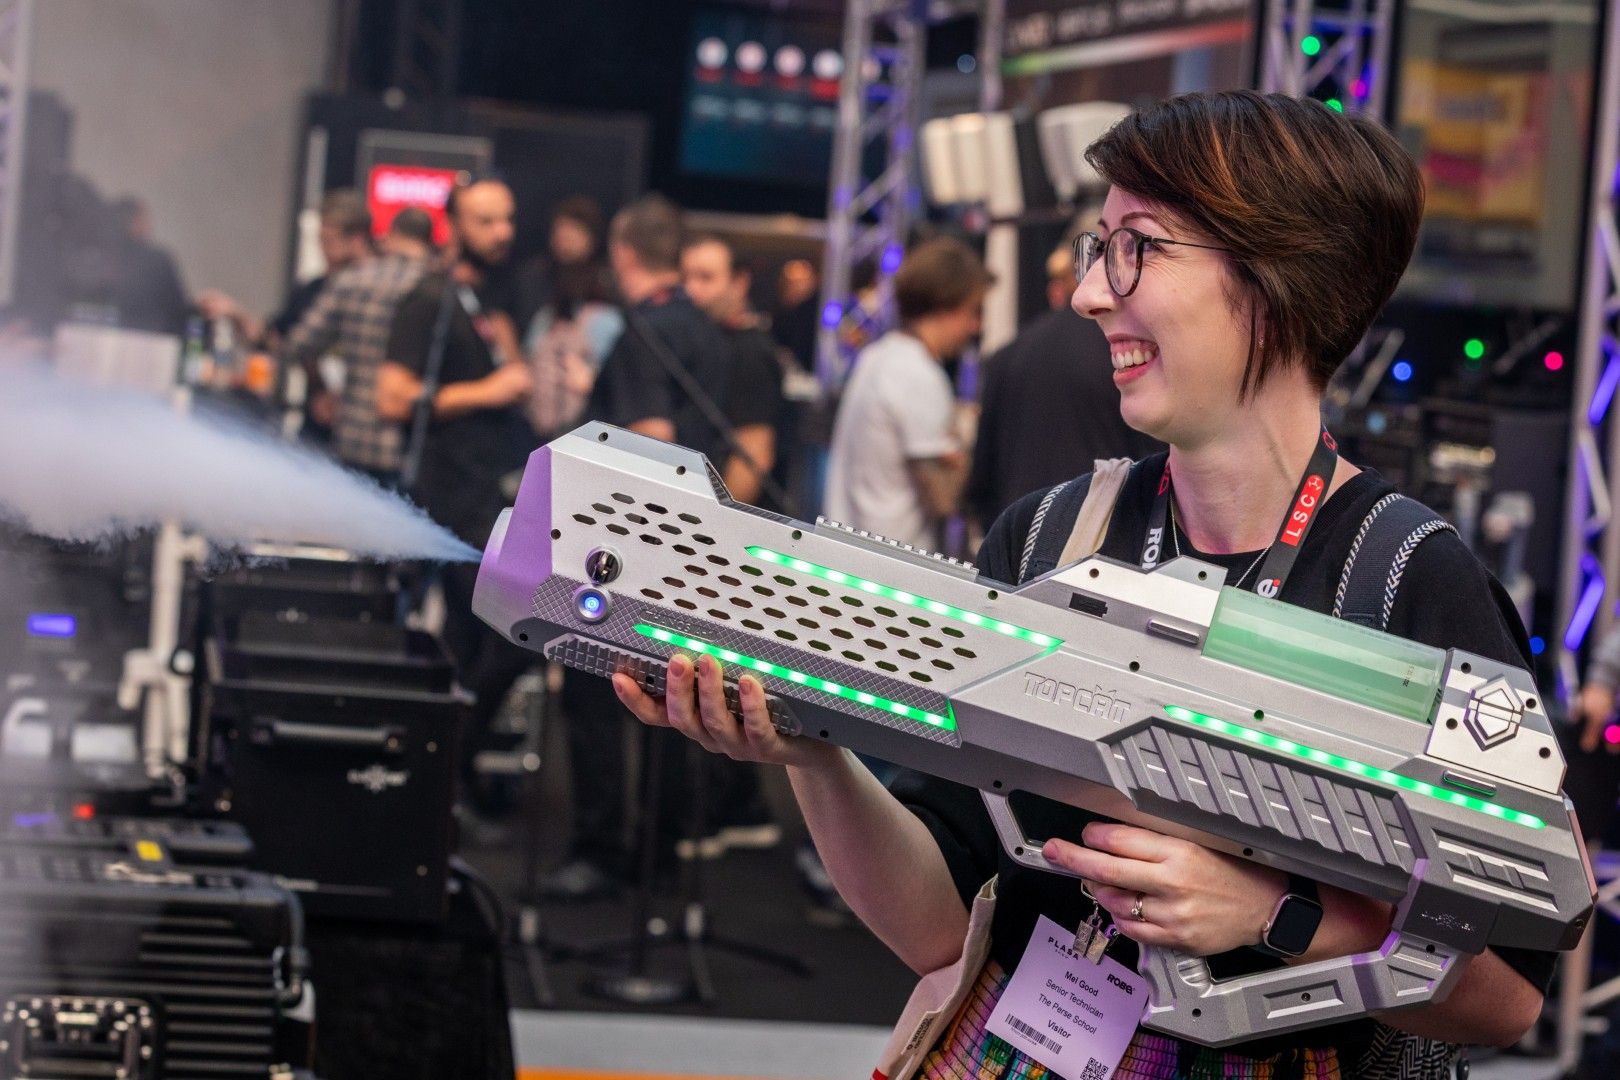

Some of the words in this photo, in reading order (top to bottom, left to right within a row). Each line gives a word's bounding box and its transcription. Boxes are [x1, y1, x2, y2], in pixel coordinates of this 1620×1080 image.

[1286, 494, 1315, 537] LSC
[1024, 671, 1132, 724] TOPCAT
[1047, 936, 1079, 961] PLASA
[1045, 978, 1069, 997] Senior
[1069, 992, 1104, 1020] Technician
[1064, 970, 1079, 985] Mel
[1079, 979, 1099, 997] Good
[1038, 993, 1052, 1007] The
[1052, 1003, 1073, 1020] Perse
[1073, 1015, 1097, 1035] School
[1047, 1021, 1072, 1039] Visitor
